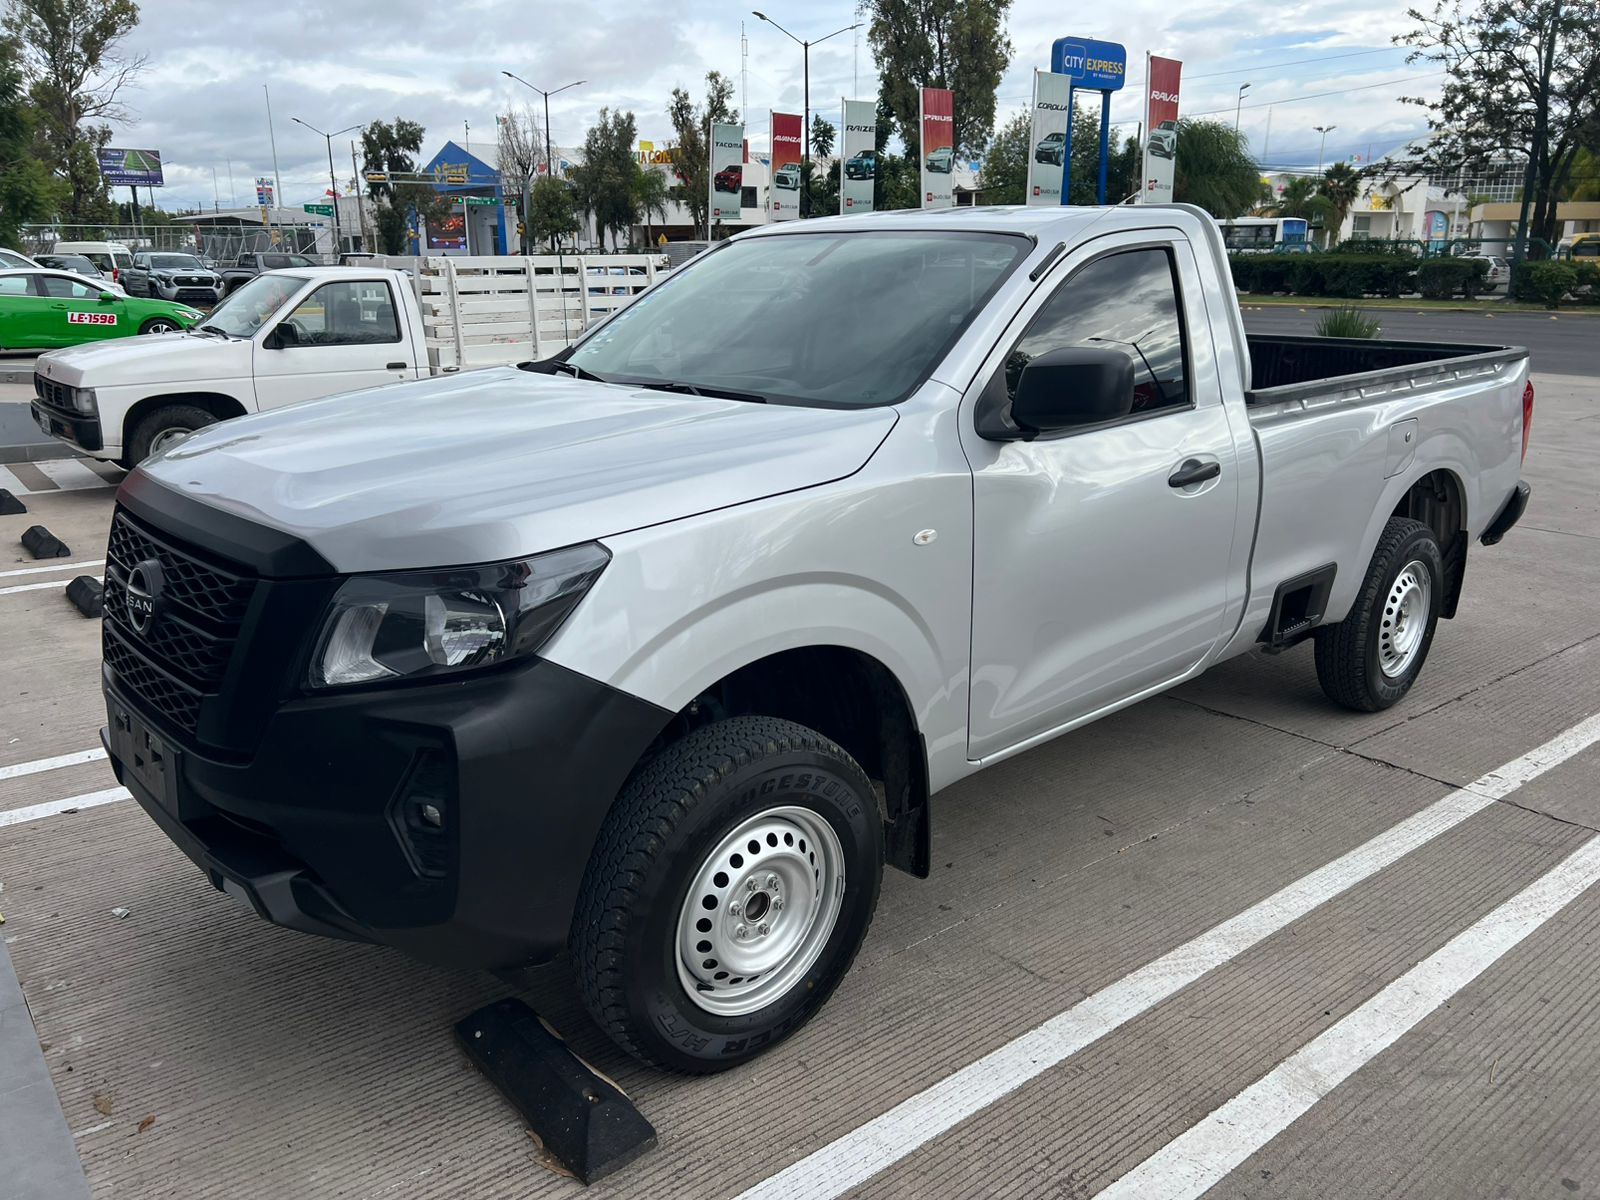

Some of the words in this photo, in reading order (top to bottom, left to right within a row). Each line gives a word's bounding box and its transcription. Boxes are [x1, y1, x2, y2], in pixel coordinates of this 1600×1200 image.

[1064, 55, 1084, 69] CITY
[1086, 58, 1123, 75] EXPRESS
[1151, 90, 1178, 103] RAV4
[1037, 102, 1067, 112] COROLLA
[923, 114, 953, 122] PRIUS
[774, 135, 801, 143] AVANZA
[715, 141, 742, 149] TACOMA
[70, 312, 115, 324] LE-1598
